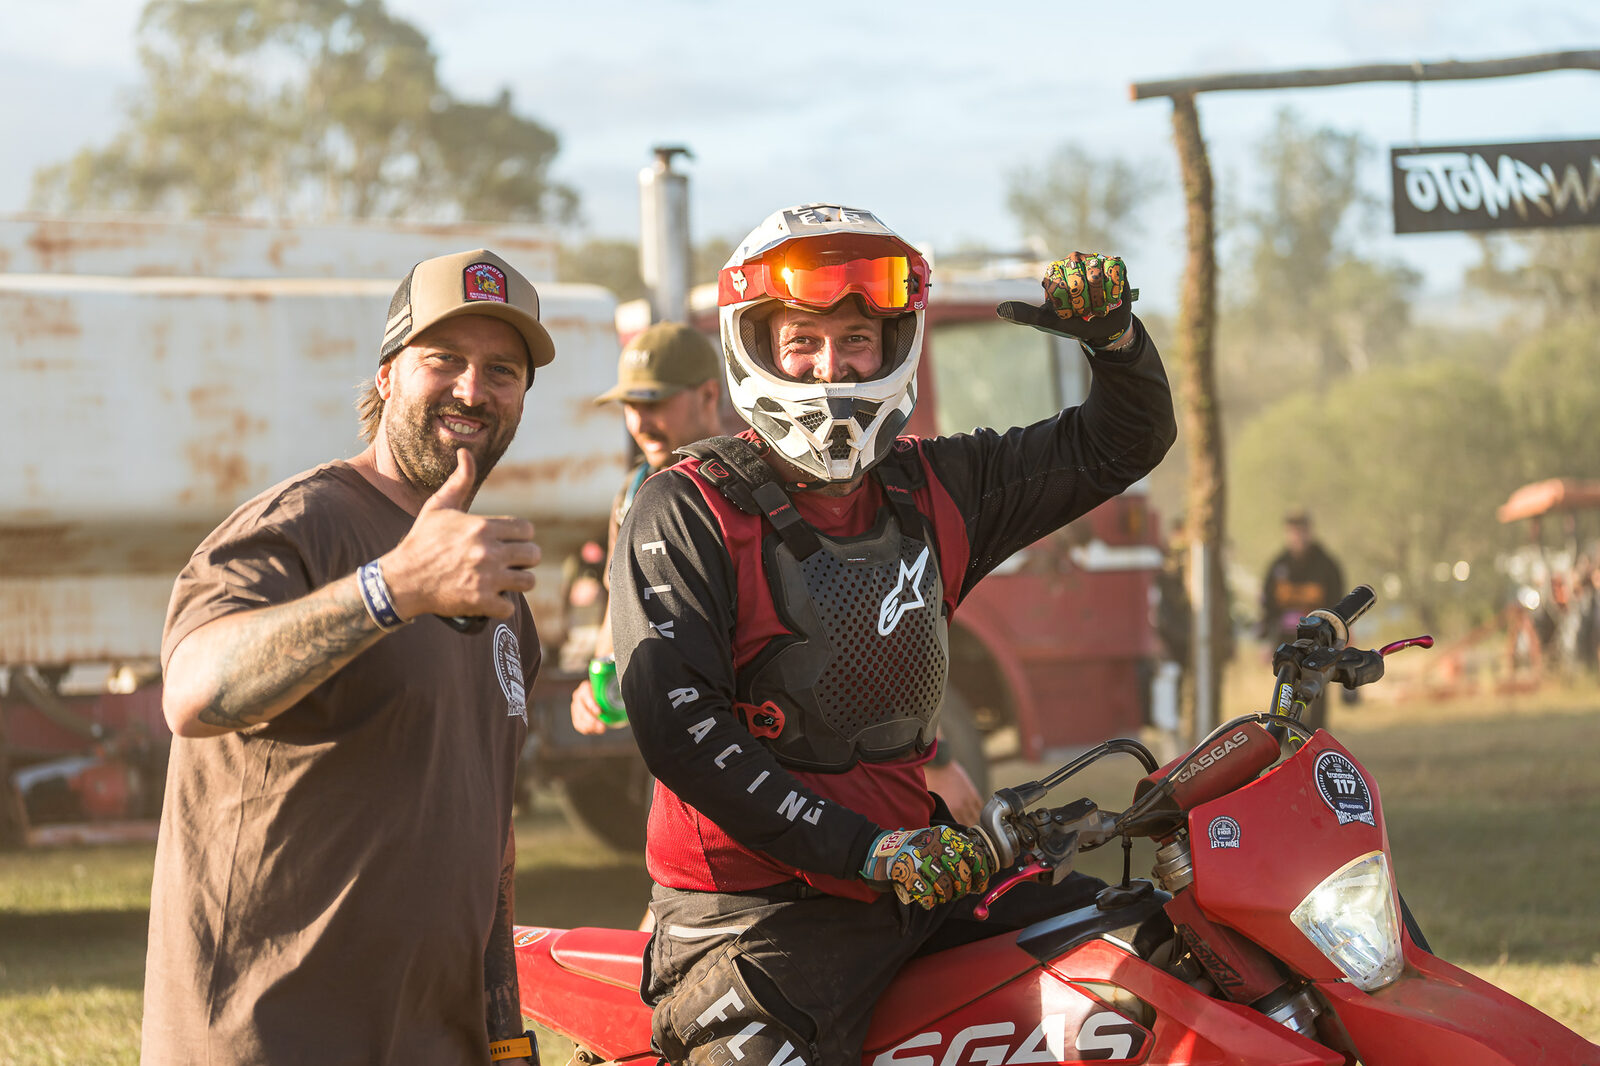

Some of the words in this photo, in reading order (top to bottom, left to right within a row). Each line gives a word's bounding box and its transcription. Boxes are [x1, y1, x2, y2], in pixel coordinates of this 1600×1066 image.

[642, 540, 675, 639] FLY
[667, 686, 825, 826] RACING
[1279, 684, 1293, 717] OTAPER
[1178, 731, 1249, 784] GASGAS
[1333, 779, 1356, 794] 117
